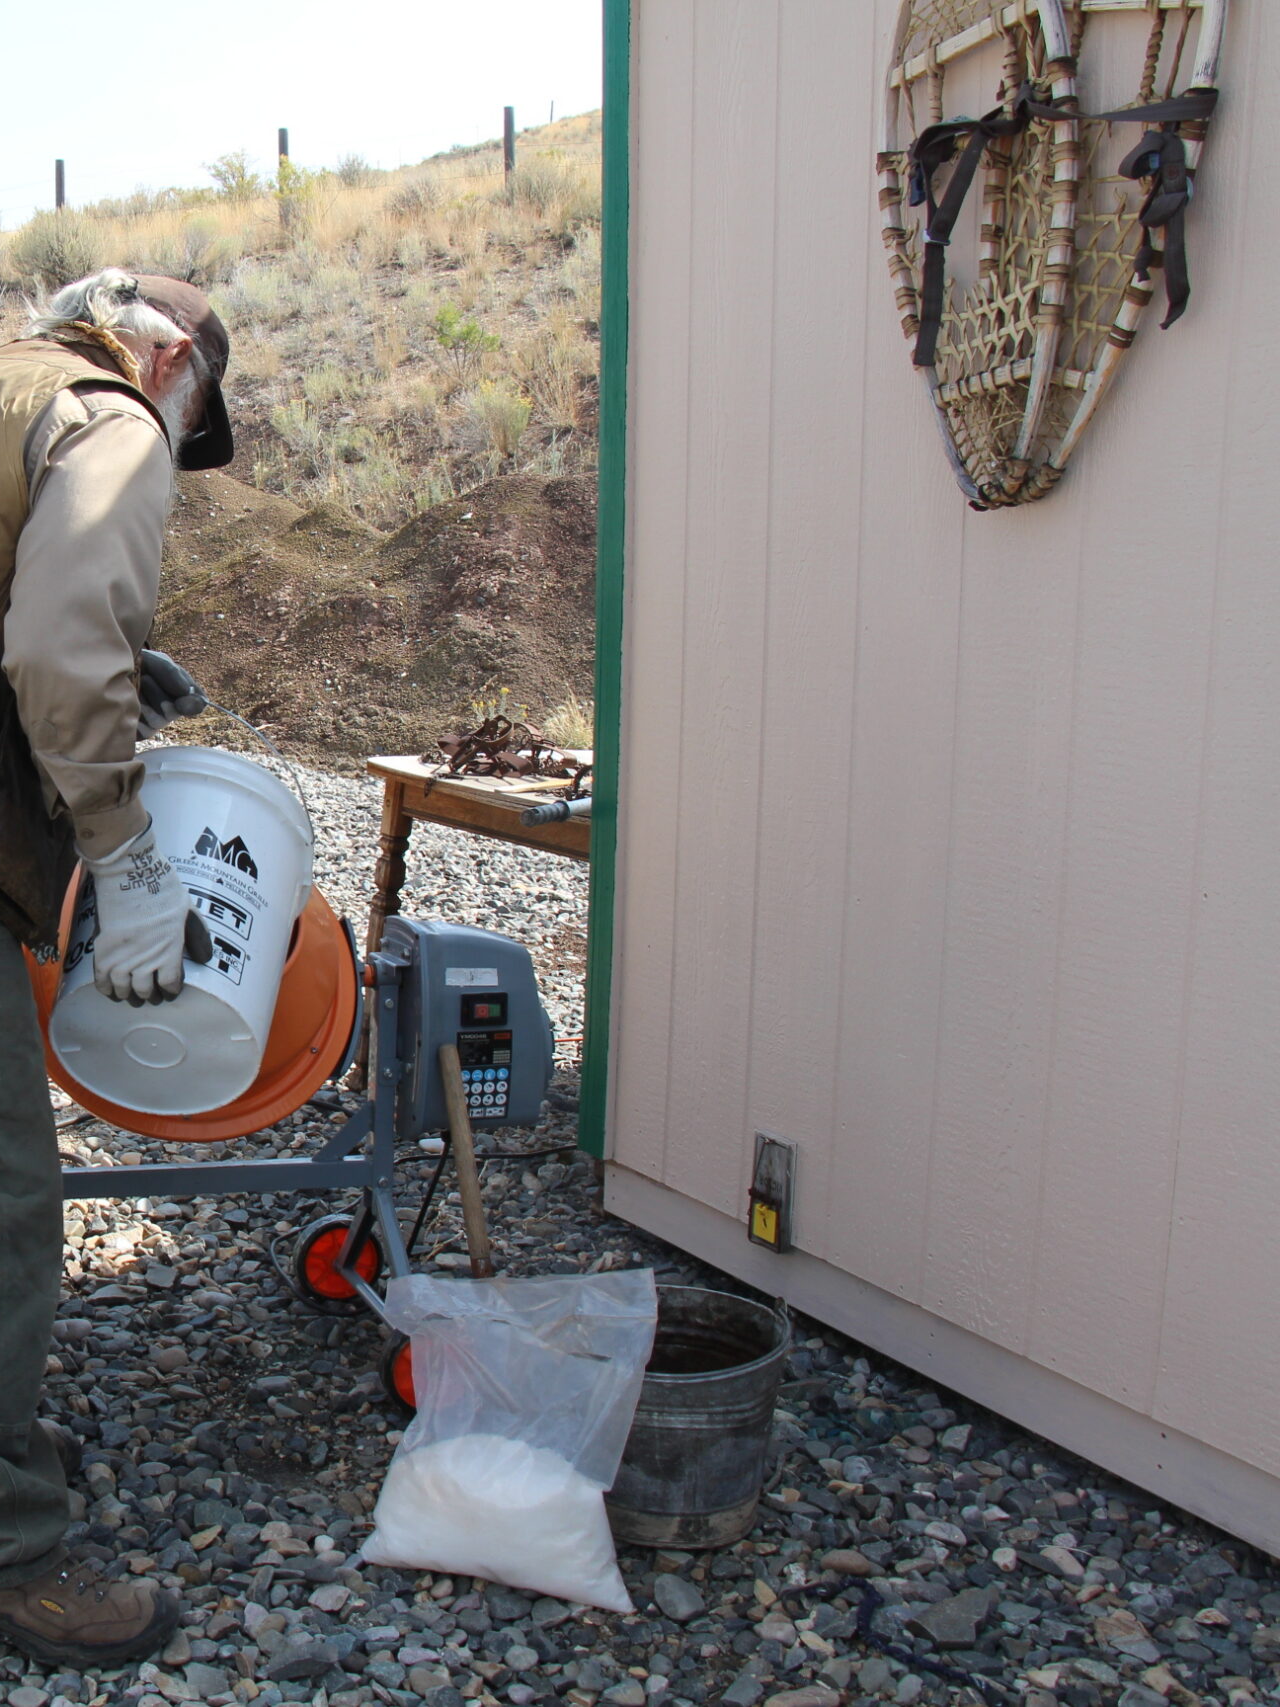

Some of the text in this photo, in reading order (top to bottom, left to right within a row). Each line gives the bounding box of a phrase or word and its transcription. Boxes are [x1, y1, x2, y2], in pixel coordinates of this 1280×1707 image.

[127, 858, 163, 881] ATLAS
[194, 829, 257, 880] GMG
[201, 863, 247, 888] MOUNTAIN
[247, 885, 269, 908] GRILLS
